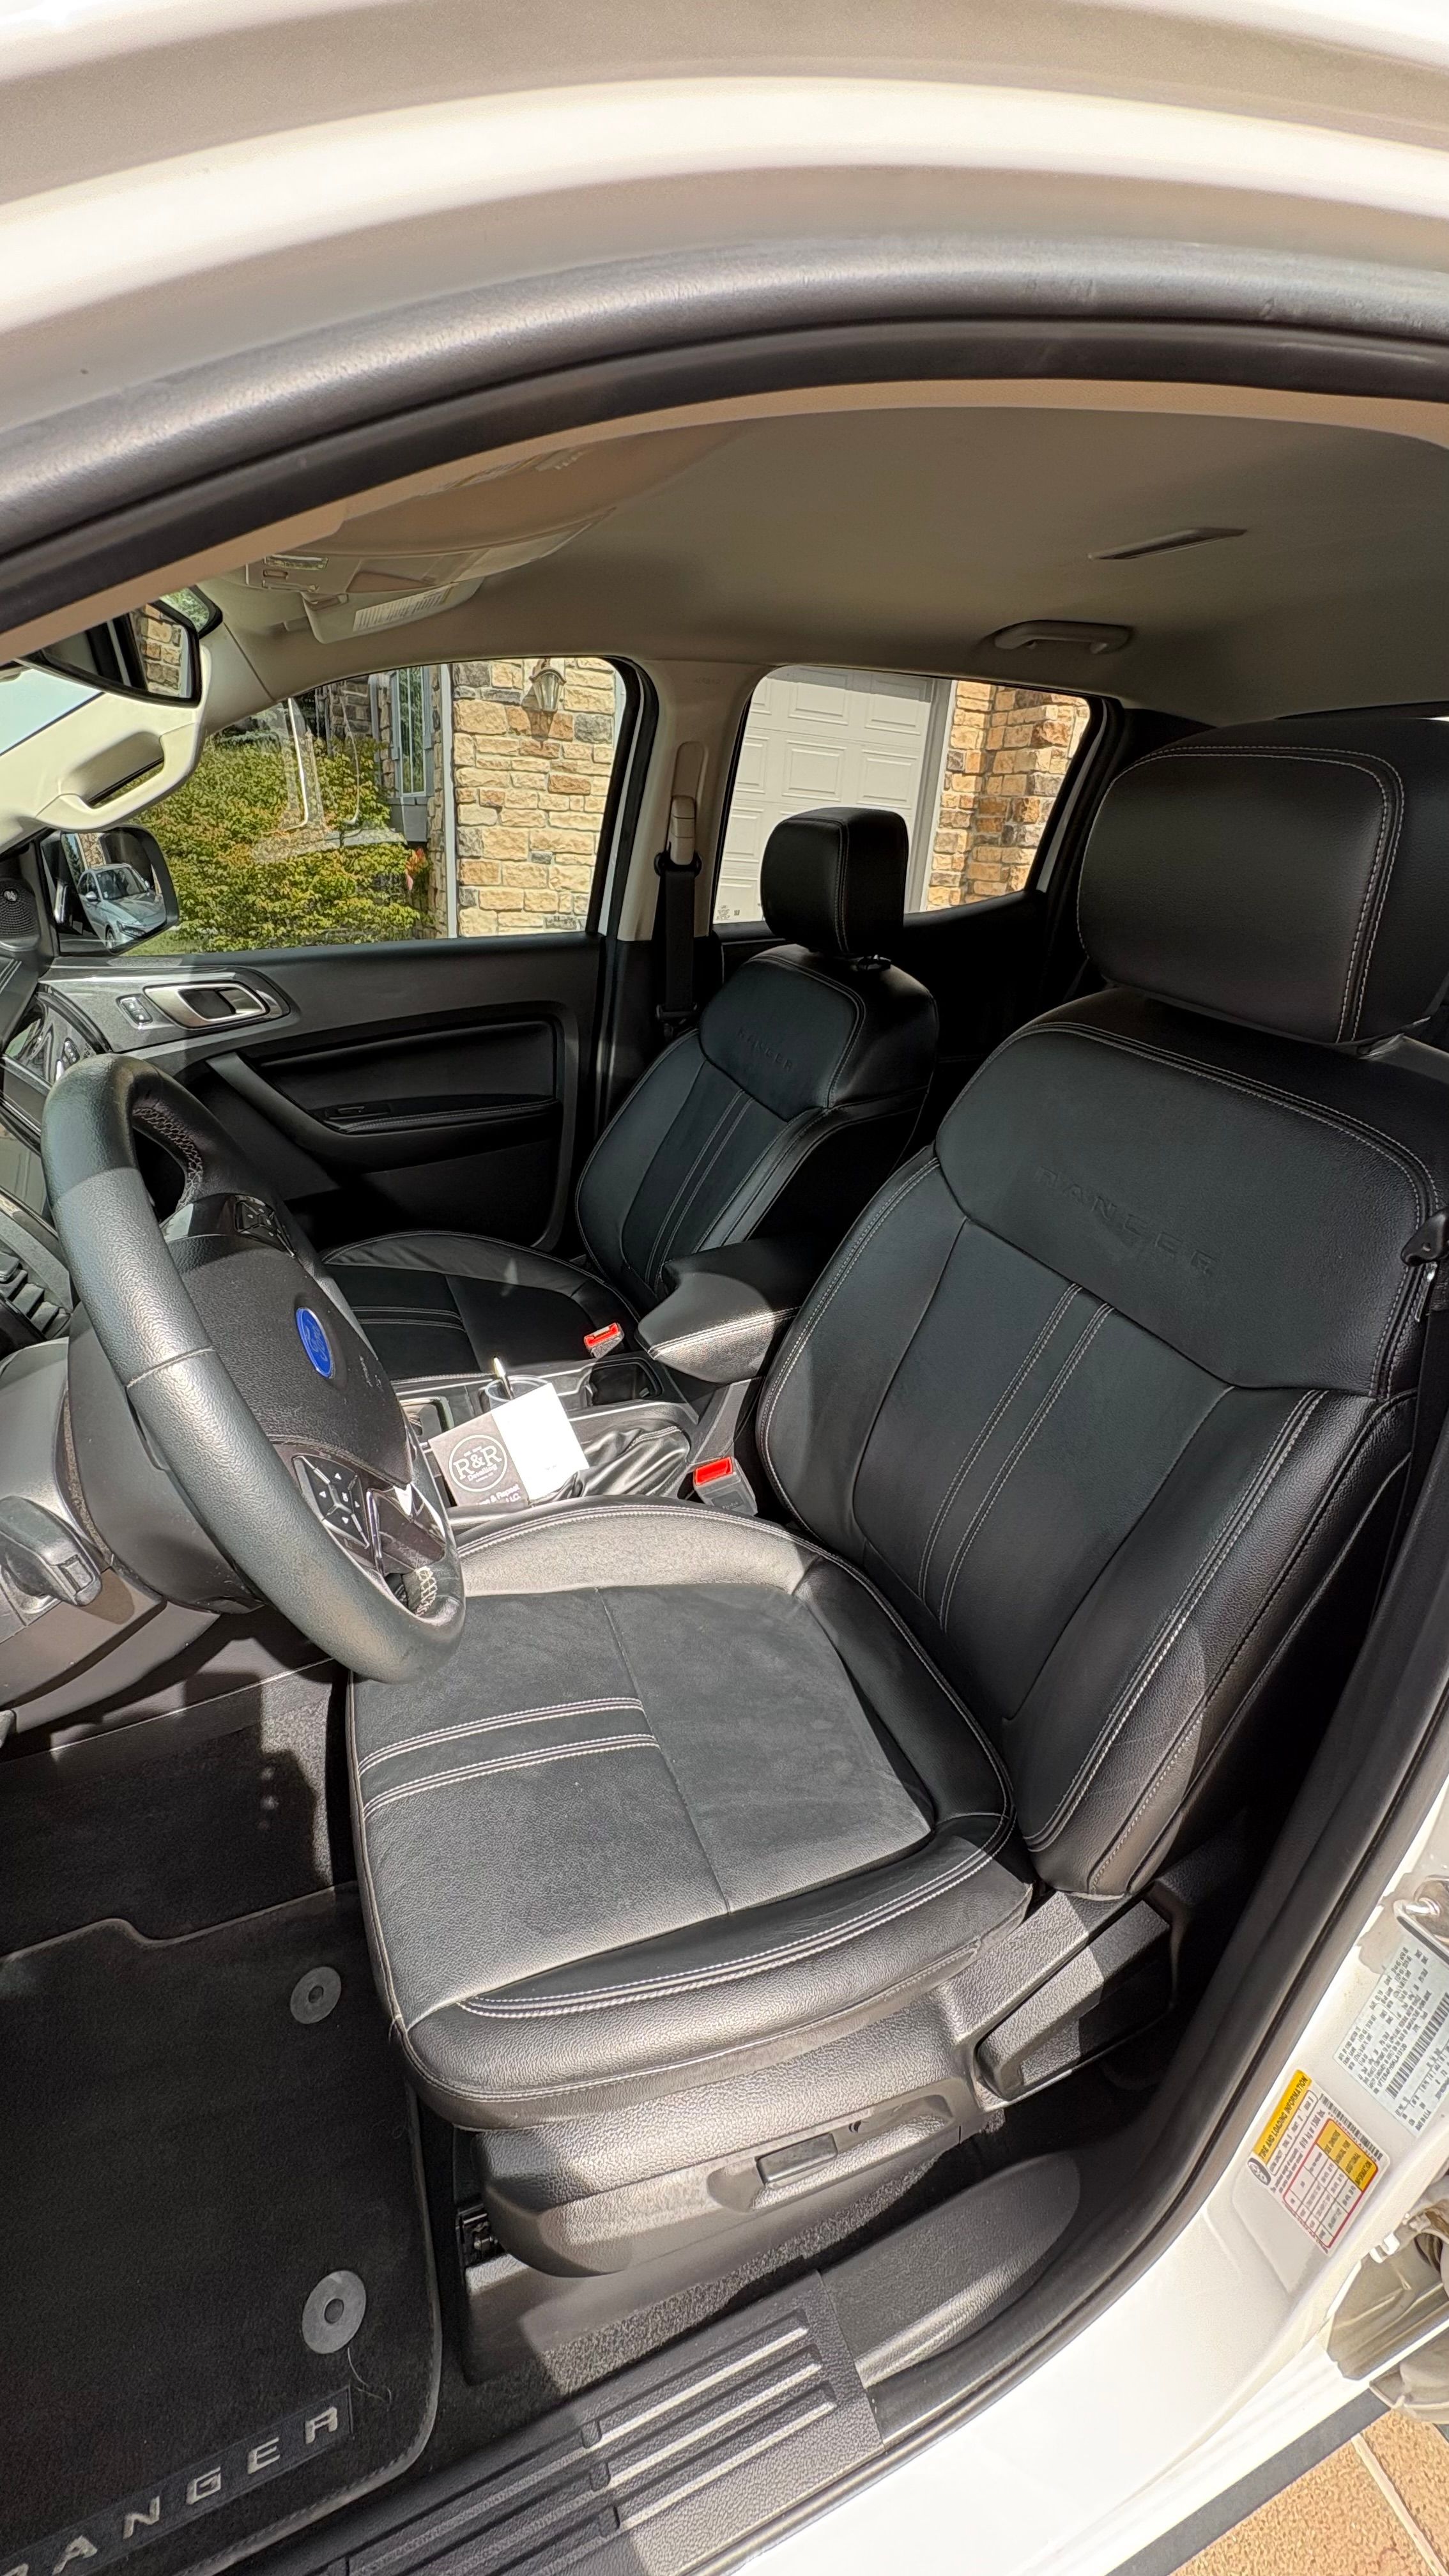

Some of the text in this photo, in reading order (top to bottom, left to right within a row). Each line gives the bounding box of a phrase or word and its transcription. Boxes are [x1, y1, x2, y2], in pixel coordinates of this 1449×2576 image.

[305, 1319, 328, 1361] Ford
[453, 1445, 502, 1480] R&R
[467, 1464, 498, 1482] Detailing
[1258, 2145, 1269, 2159] TIRE
[1265, 2134, 1275, 2149] AND
[1271, 2112, 1288, 2138] LOADING
[1284, 2074, 1308, 2114] INFORMATION
